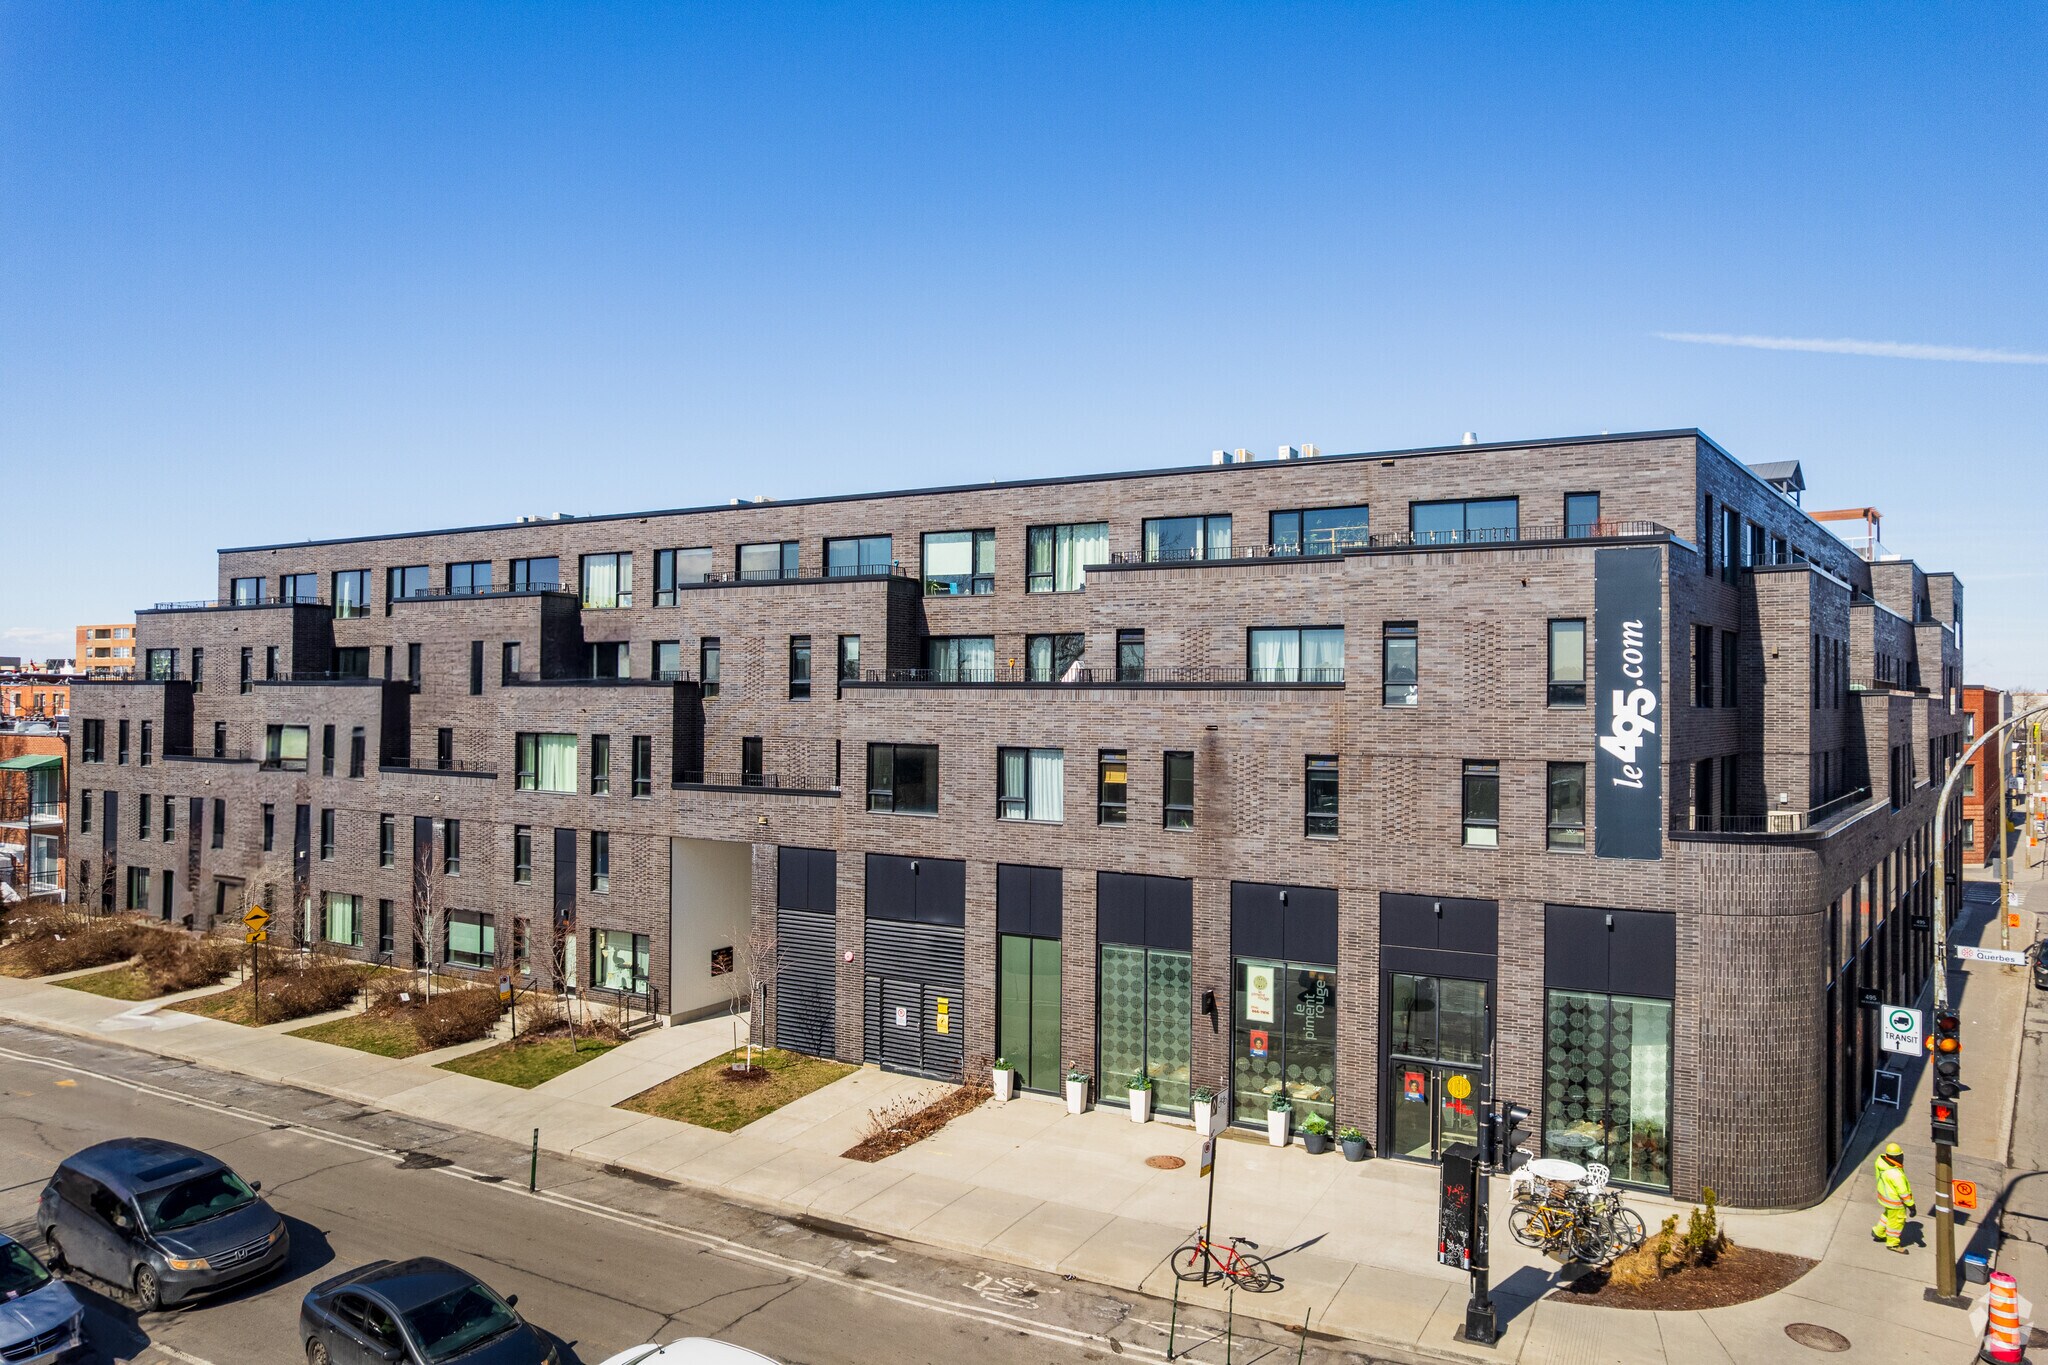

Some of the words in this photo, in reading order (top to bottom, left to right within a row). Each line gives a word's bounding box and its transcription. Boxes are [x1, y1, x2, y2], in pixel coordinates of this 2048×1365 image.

[1977, 952, 2015, 962] Querbes
[1316, 979, 1329, 1019] rouge
[1293, 1004, 1305, 1015] le
[1303, 993, 1317, 1040] piment
[1885, 1031, 1918, 1044] TRANSIT
